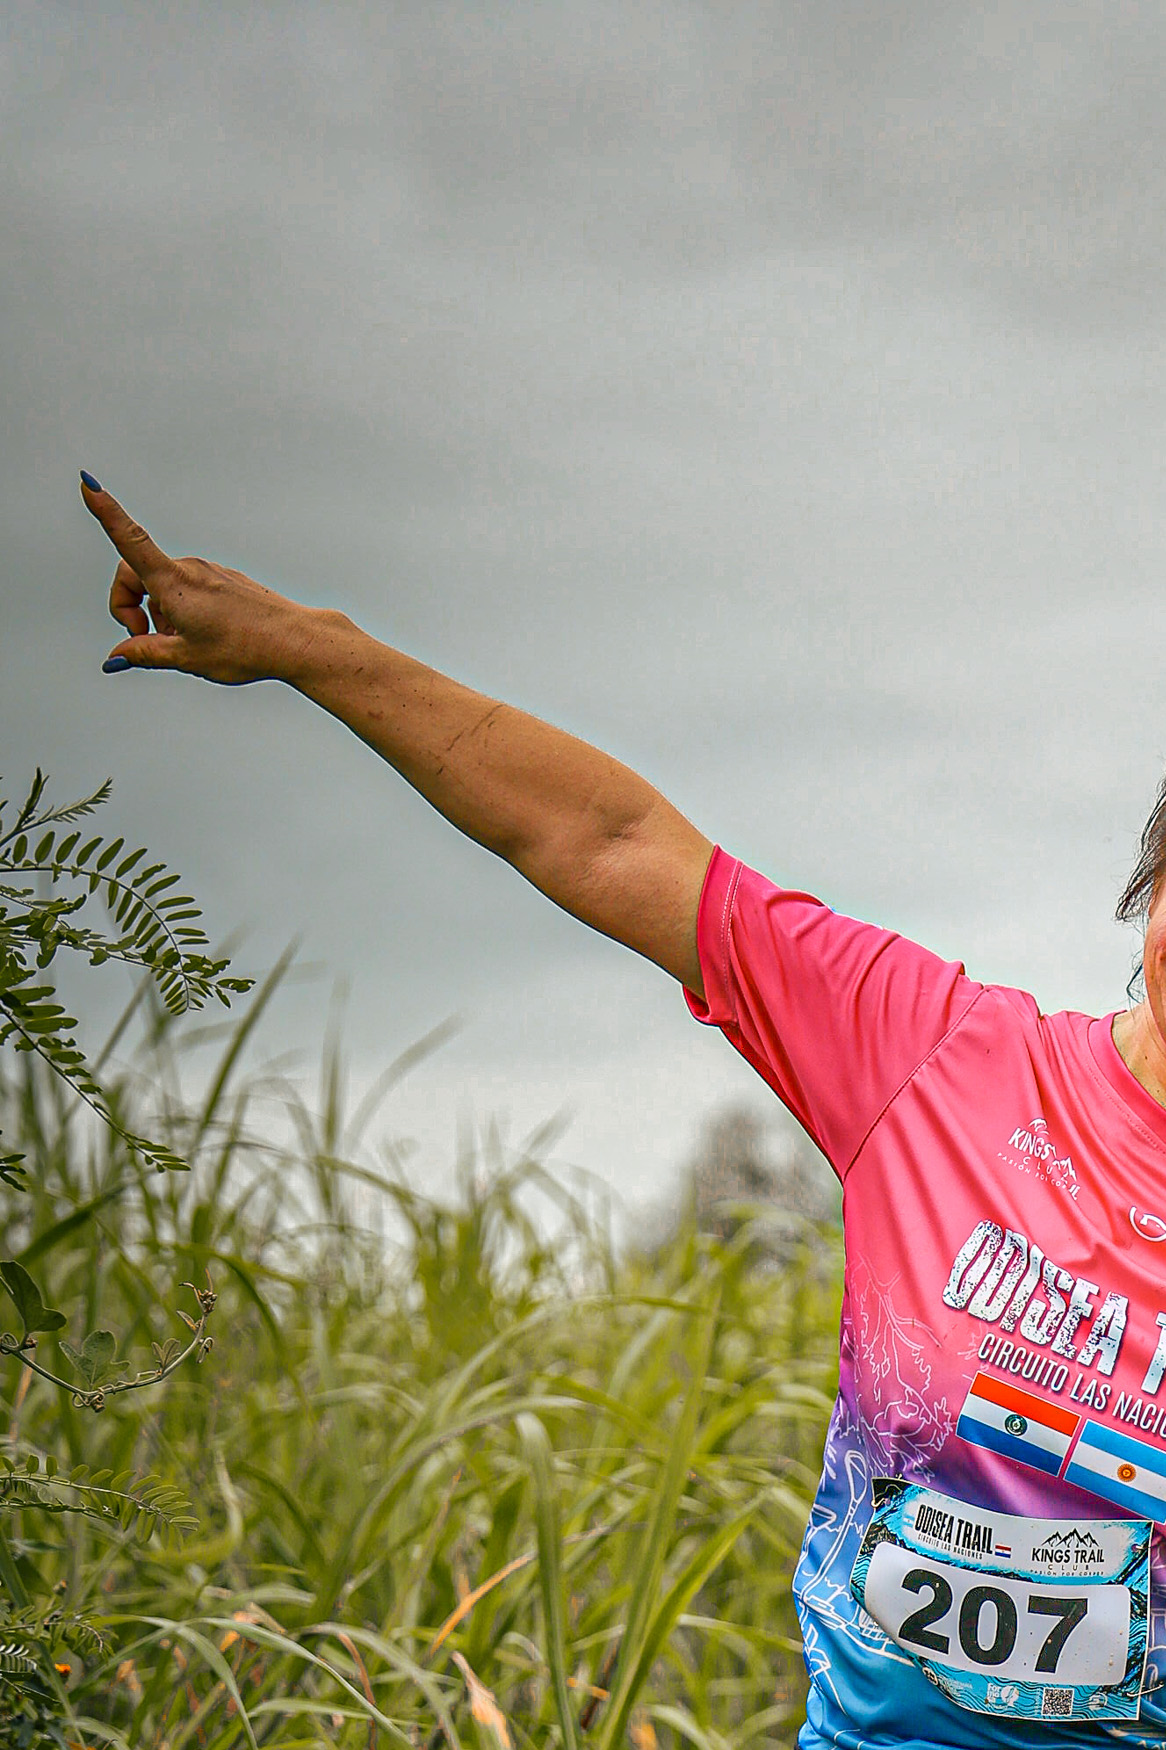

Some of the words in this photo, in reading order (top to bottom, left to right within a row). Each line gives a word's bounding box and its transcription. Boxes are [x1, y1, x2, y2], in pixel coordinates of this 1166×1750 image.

[1008, 1127, 1054, 1160] KINGS
[942, 1219, 1129, 1377] ODISEA
[977, 1333, 1069, 1393] CIRCUITO
[1070, 1373, 1112, 1411] LAS
[915, 1504, 955, 1544] ODISEA
[954, 1518, 993, 1555] TRAIL
[953, 1547, 983, 1560] NACIONES
[1031, 1547, 1071, 1564] KINGS
[1074, 1549, 1105, 1564] TRAIL
[898, 1567, 1089, 1675] 207
